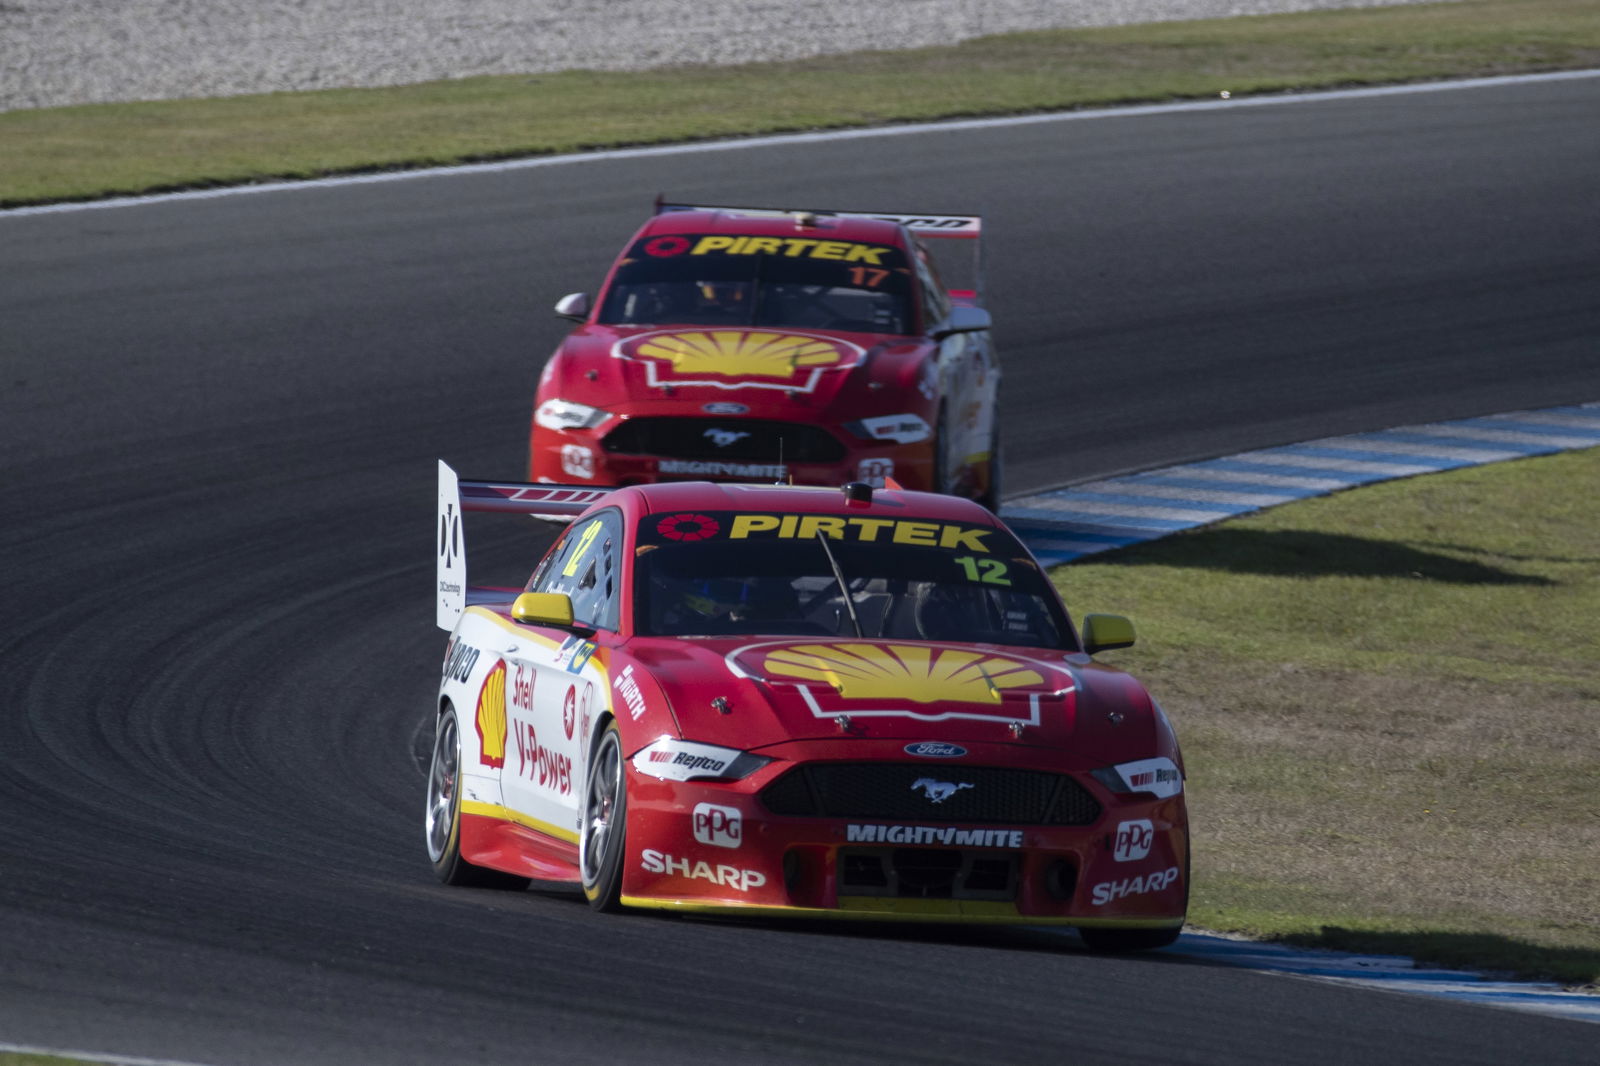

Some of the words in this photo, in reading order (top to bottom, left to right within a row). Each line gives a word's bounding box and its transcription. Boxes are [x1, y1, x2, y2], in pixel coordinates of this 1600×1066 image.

[690, 236, 893, 265] PIRTEK
[849, 266, 890, 288] 17
[729, 515, 993, 553] PIRTEK
[954, 556, 1012, 586] 12
[513, 663, 536, 711] Shell
[514, 717, 571, 796] V-Power
[673, 752, 726, 772] Repco
[917, 743, 955, 755] Ford
[695, 808, 741, 841] PPG
[1117, 824, 1153, 857] PPG
[641, 848, 766, 892] SHARP
[1092, 867, 1178, 905] SHARP
